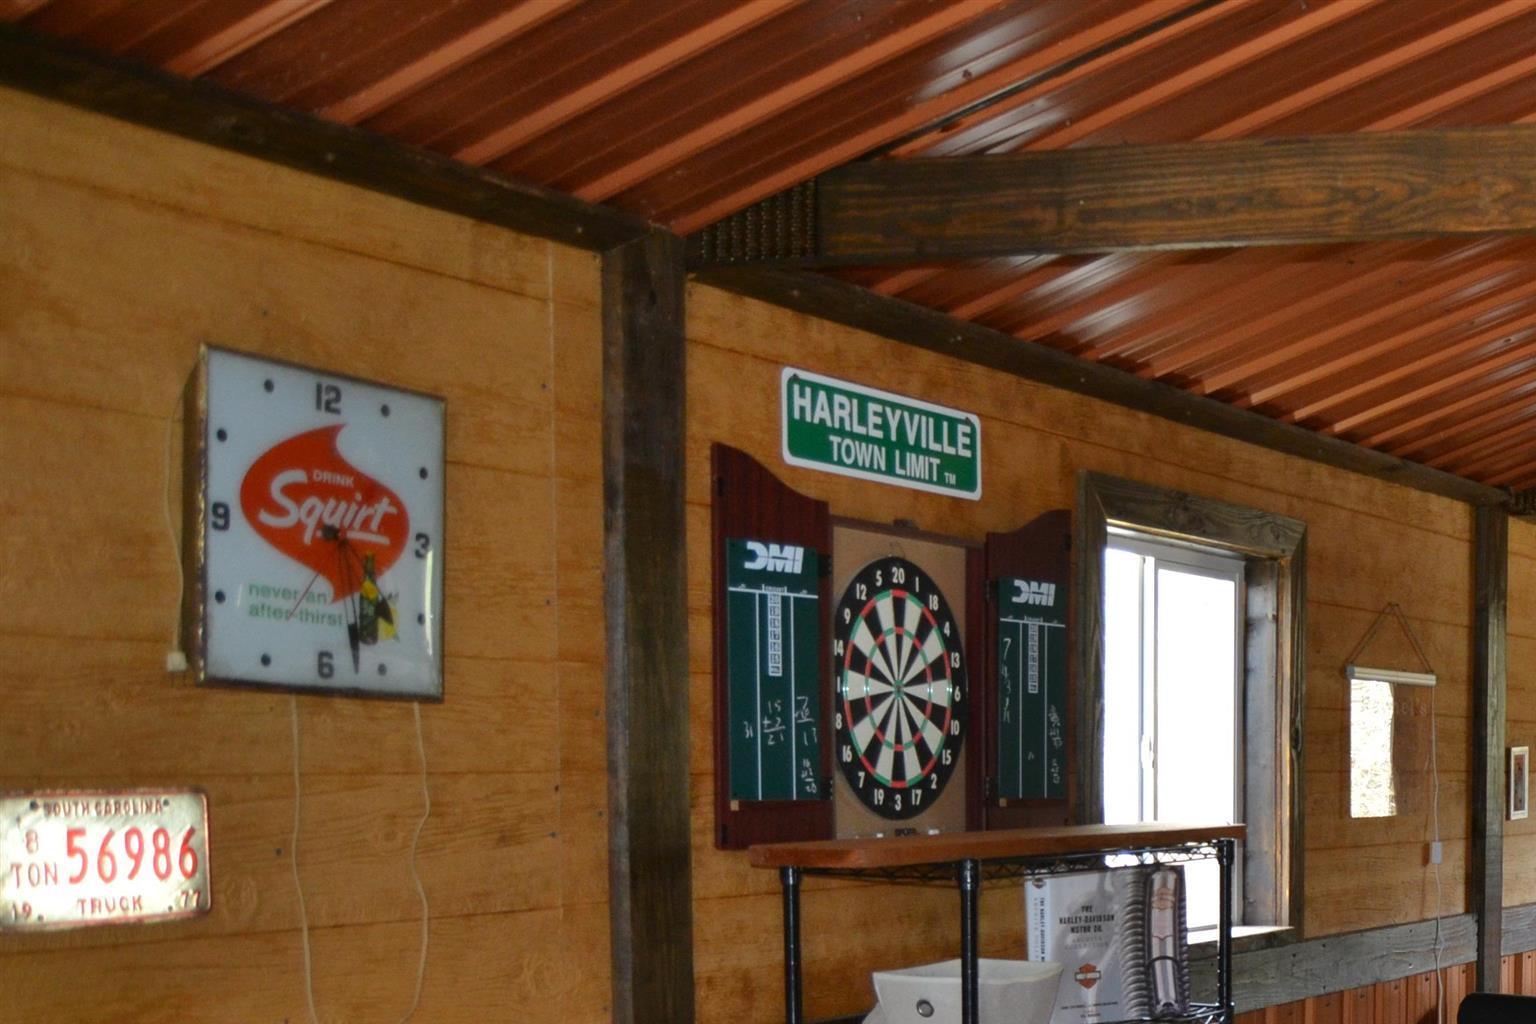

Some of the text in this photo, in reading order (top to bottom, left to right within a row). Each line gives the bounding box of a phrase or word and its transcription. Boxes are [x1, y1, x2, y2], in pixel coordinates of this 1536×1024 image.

[315, 382, 342, 415] 12
[792, 383, 972, 458] HARLEYVILLE
[828, 434, 886, 471] TOWN
[894, 449, 941, 481] LIMIT
[312, 469, 355, 488] DRINK
[258, 468, 398, 545] Squirt
[211, 502, 231, 531] 9
[414, 532, 431, 560] 3
[875, 570, 882, 586] 5
[891, 566, 905, 584] 20
[248, 583, 299, 602] never
[855, 583, 867, 600] 12
[929, 594, 939, 611] 18
[843, 608, 851, 624] 9
[943, 621, 950, 637] 4
[834, 639, 844, 656] 14
[316, 650, 335, 679] 6
[951, 652, 960, 668] 13
[954, 686, 961, 702] 6
[836, 713, 842, 730] 8
[951, 719, 960, 735] 10
[842, 745, 852, 762] 16
[942, 749, 952, 765] 15
[858, 771, 865, 788] 7
[931, 773, 937, 789] 2
[874, 788, 885, 805] 19
[894, 794, 901, 811] 3
[911, 788, 922, 805] 17
[44, 799, 163, 816] SOUTH CAROLINA
[25, 829, 39, 854] 8
[66, 826, 198, 884] 56986
[11, 861, 58, 889] TON
[77, 894, 143, 916] TRUCK
